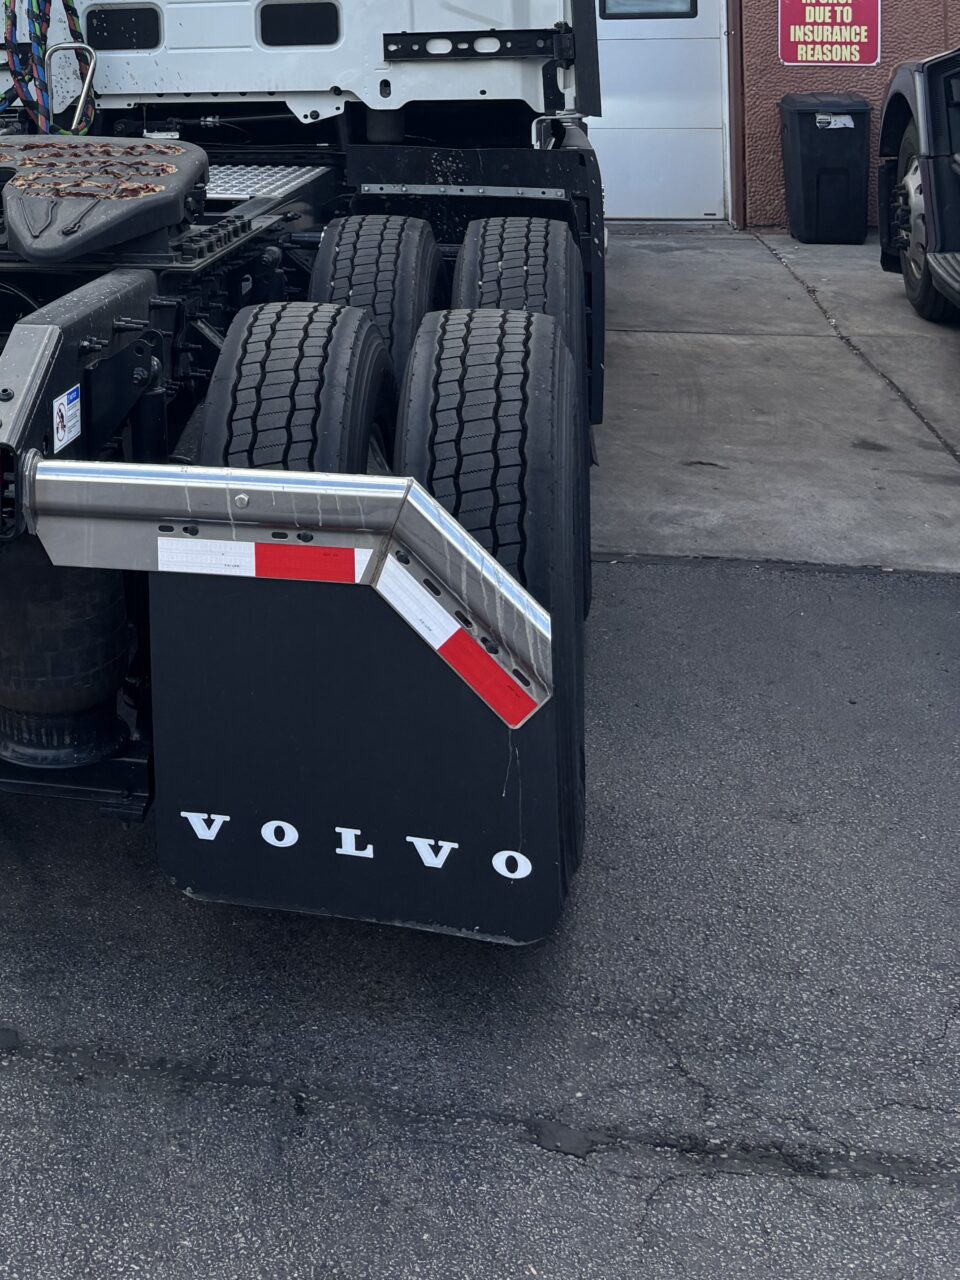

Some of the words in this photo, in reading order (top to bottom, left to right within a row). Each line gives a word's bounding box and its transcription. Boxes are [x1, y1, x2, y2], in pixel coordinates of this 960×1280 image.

[805, 6, 832, 23] DUE
[834, 6, 853, 23] TO
[790, 25, 869, 43] INSURANCE
[797, 44, 860, 62] REASONS
[180, 811, 533, 880] VOLVO
